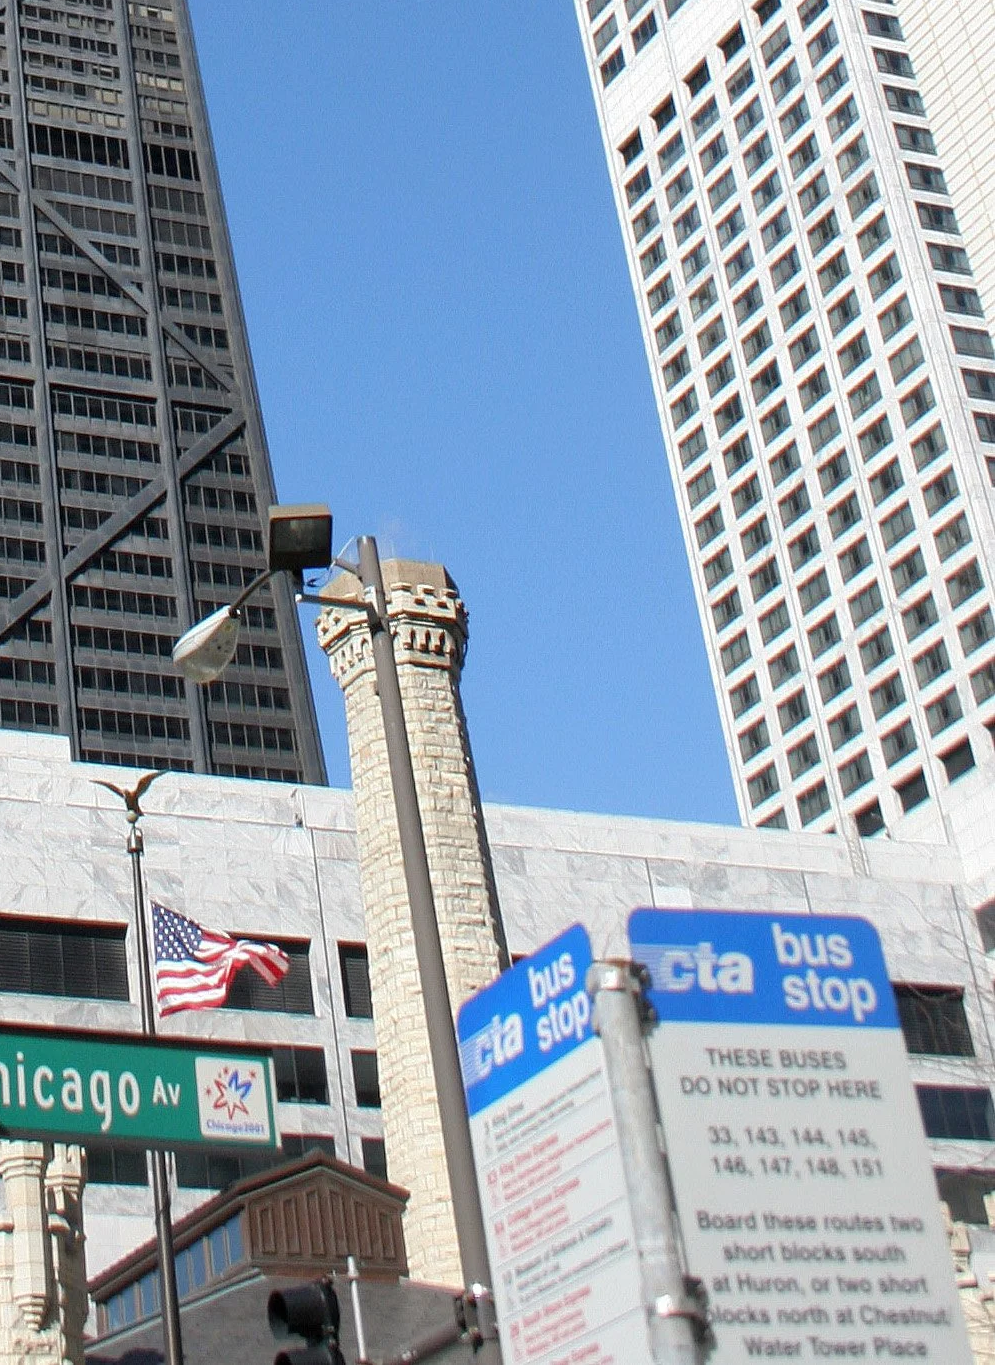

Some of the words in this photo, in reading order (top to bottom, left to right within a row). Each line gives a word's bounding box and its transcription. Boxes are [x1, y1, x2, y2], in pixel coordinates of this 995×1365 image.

[771, 921, 854, 969] bus
[527, 950, 576, 1009] bus
[659, 941, 754, 993] cta
[782, 970, 878, 1022] stop
[536, 989, 590, 1053] stop
[471, 1010, 525, 1079] cta
[705, 1046, 774, 1069] THESE
[778, 1048, 847, 1071] BUSES
[152, 1074, 181, 1108] Av
[679, 1075, 711, 1096] DO
[717, 1076, 759, 1098] NOT
[766, 1077, 821, 1099] STOP
[826, 1078, 882, 1101] HERE
[708, 1125, 740, 1147] 33,
[745, 1125, 786, 1148] 143,
[851, 1157, 885, 1177] 151
[695, 1210, 757, 1231] Board
[761, 1211, 817, 1231] these
[822, 1213, 884, 1232] routes
[888, 1214, 924, 1232] two
[722, 1243, 775, 1262] short
[780, 1242, 846, 1262] blocks
[851, 1243, 906, 1262] south
[711, 1275, 731, 1292] at
[736, 1273, 805, 1294] Huron,
[810, 1277, 830, 1292] or
[835, 1276, 872, 1293] two
[878, 1275, 928, 1294] short
[776, 1306, 830, 1325] north
[835, 1308, 854, 1325] at
[743, 1336, 802, 1357] Water
[806, 1336, 867, 1357] Tower
[872, 1336, 929, 1357] Place
